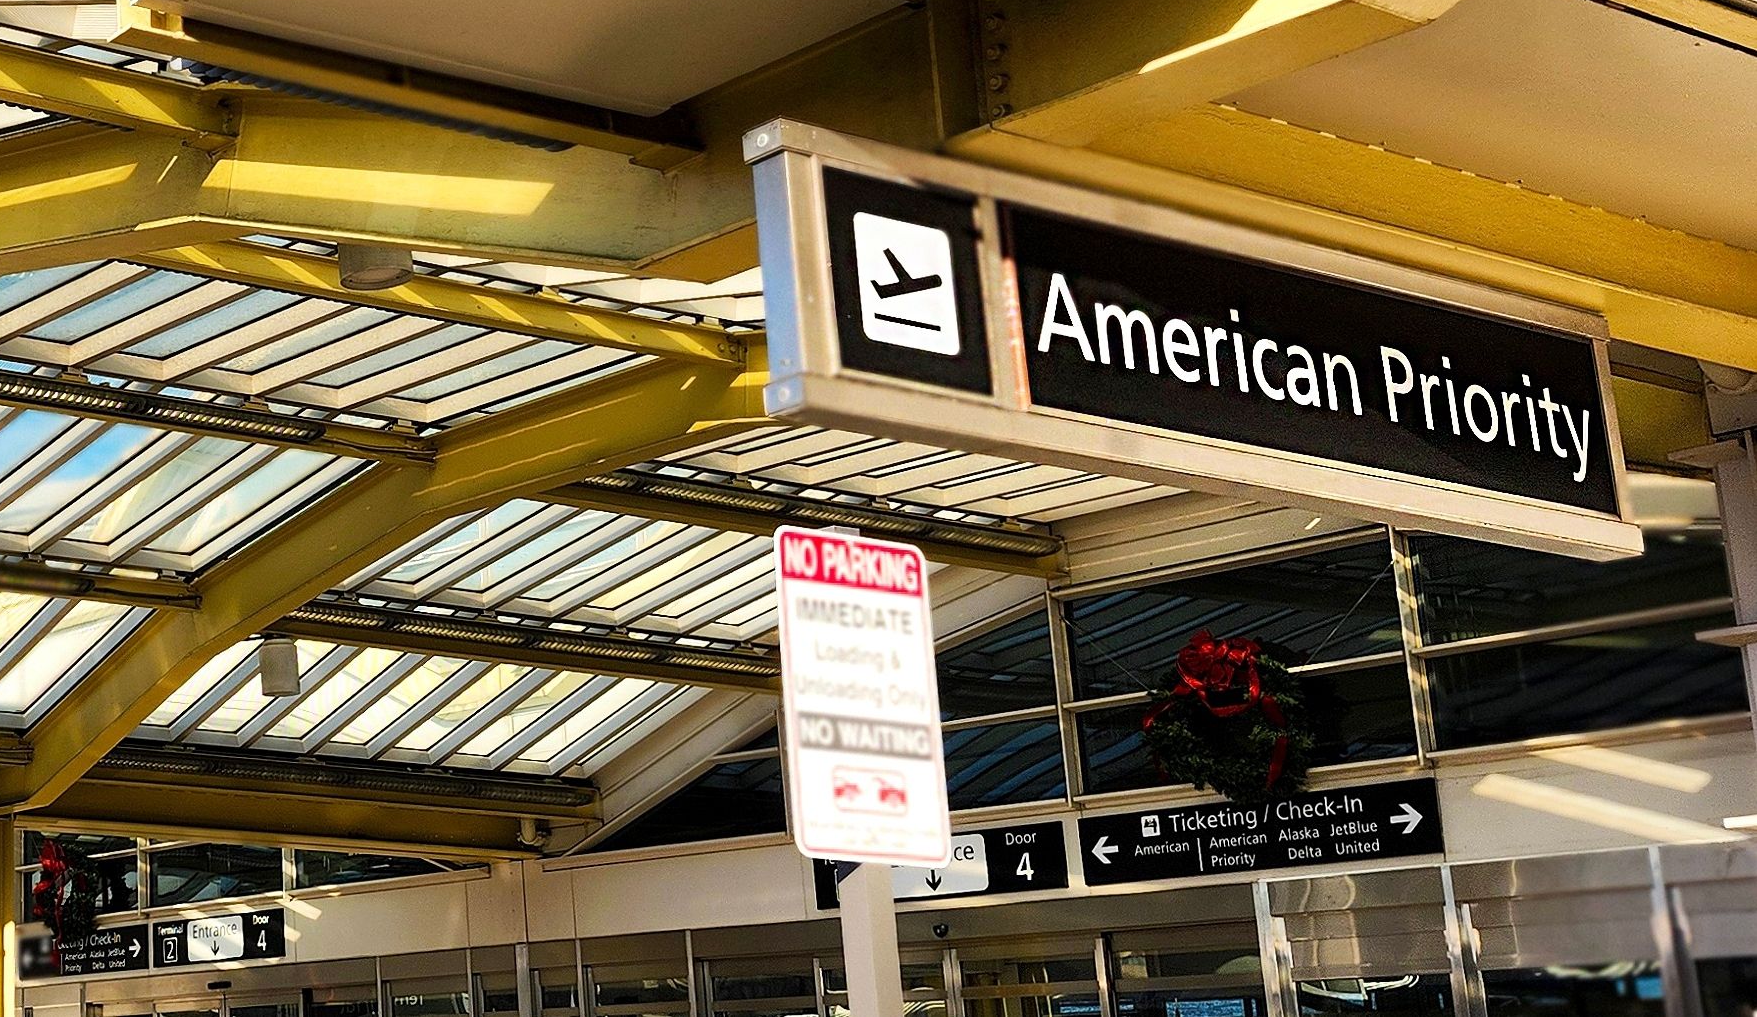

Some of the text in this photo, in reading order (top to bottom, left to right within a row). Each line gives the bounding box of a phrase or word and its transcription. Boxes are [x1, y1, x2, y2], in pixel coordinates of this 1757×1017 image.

[1037, 271, 1591, 482] American Priority
[783, 536, 919, 591] NO PARKING
[795, 596, 913, 635] IMMEDIATE
[815, 639, 884, 673] Loading
[794, 673, 883, 709] Unloading
[800, 718, 930, 754] NO WAITING
[1168, 795, 1364, 832] Ticketing / Check-In
[1005, 832, 1037, 846] Door
[1134, 841, 1190, 856] American
[1209, 820, 1378, 849] American Alaska JetBlue
[1015, 852, 1035, 881] 4
[1211, 838, 1381, 867] Priority Delta United
[158, 924, 184, 936] Terminal
[192, 923, 238, 939] Entrance
[252, 914, 269, 925] Door
[90, 932, 121, 946] Check-In
[166, 940, 174, 959] 2
[257, 930, 267, 951] 4
